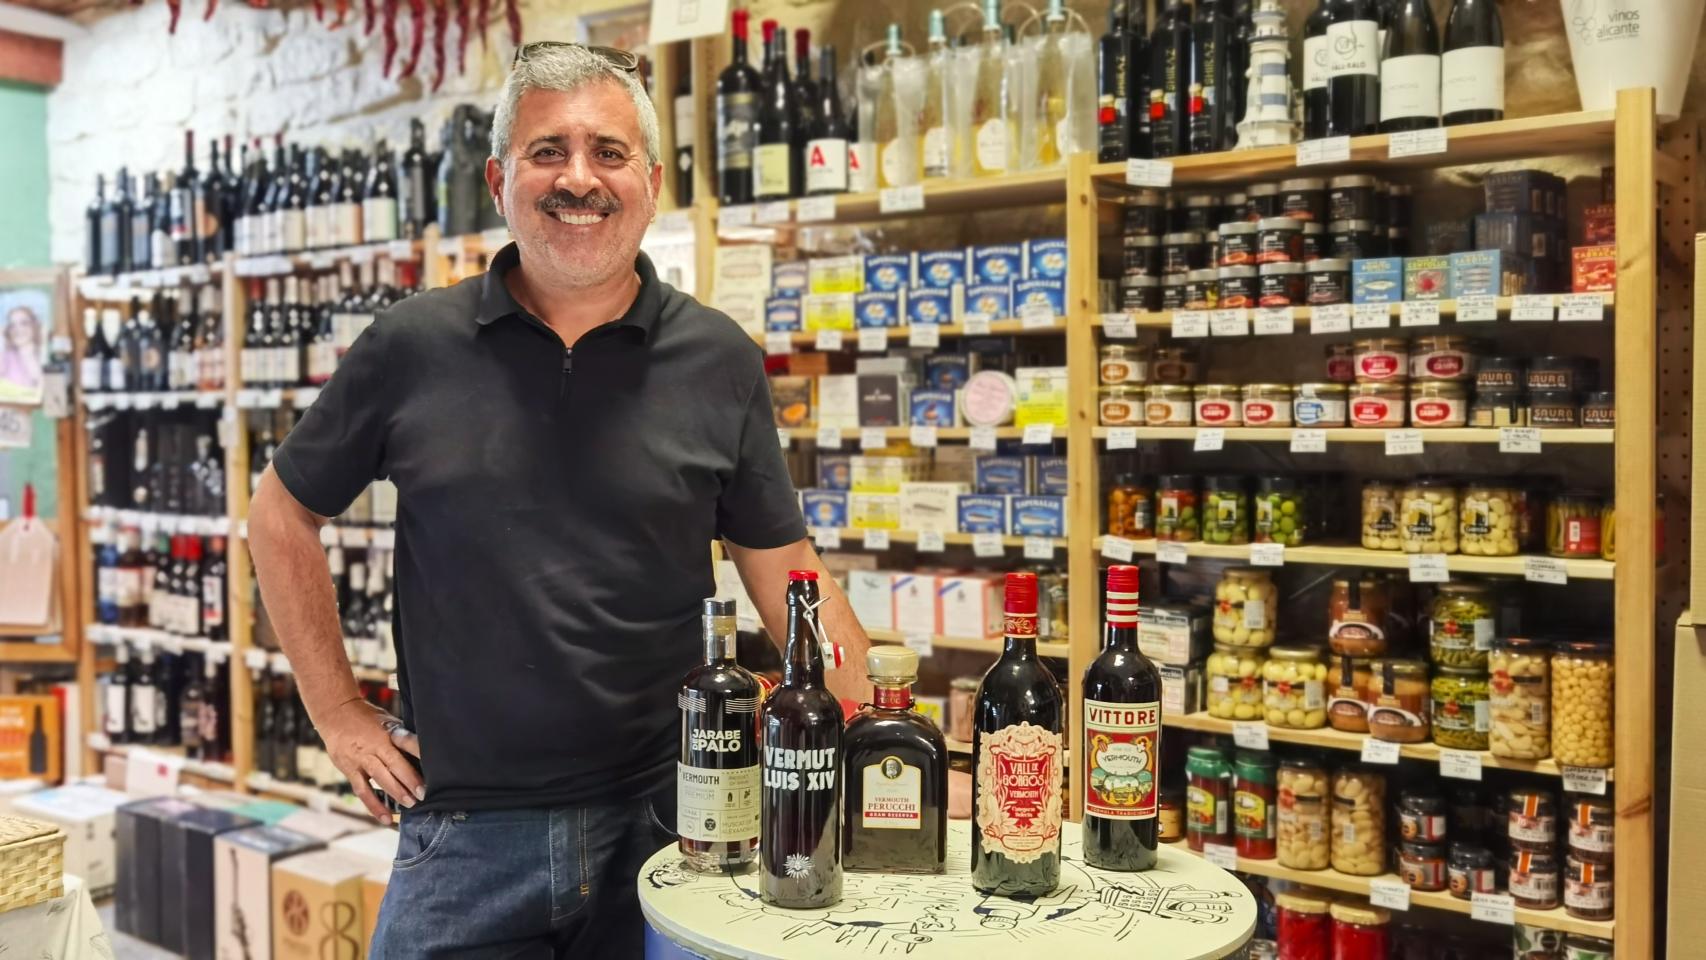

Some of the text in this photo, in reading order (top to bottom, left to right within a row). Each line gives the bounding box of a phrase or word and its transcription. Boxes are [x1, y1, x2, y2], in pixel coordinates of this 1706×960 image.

[1608, 8, 1640, 22] vinos
[1596, 21, 1640, 39] alicante
[810, 144, 826, 168] A
[1089, 707, 1156, 725] VITTORE
[692, 729, 741, 740] JARABE
[697, 739, 741, 752] PALO
[765, 745, 836, 770] VERMUT
[1103, 755, 1142, 764] VERMOUTH
[1010, 763, 1034, 775] VALL
[682, 771, 720, 785] VERMOUTH
[764, 768, 836, 791] LUIS XIV
[867, 802, 916, 811] PERUCCHI
